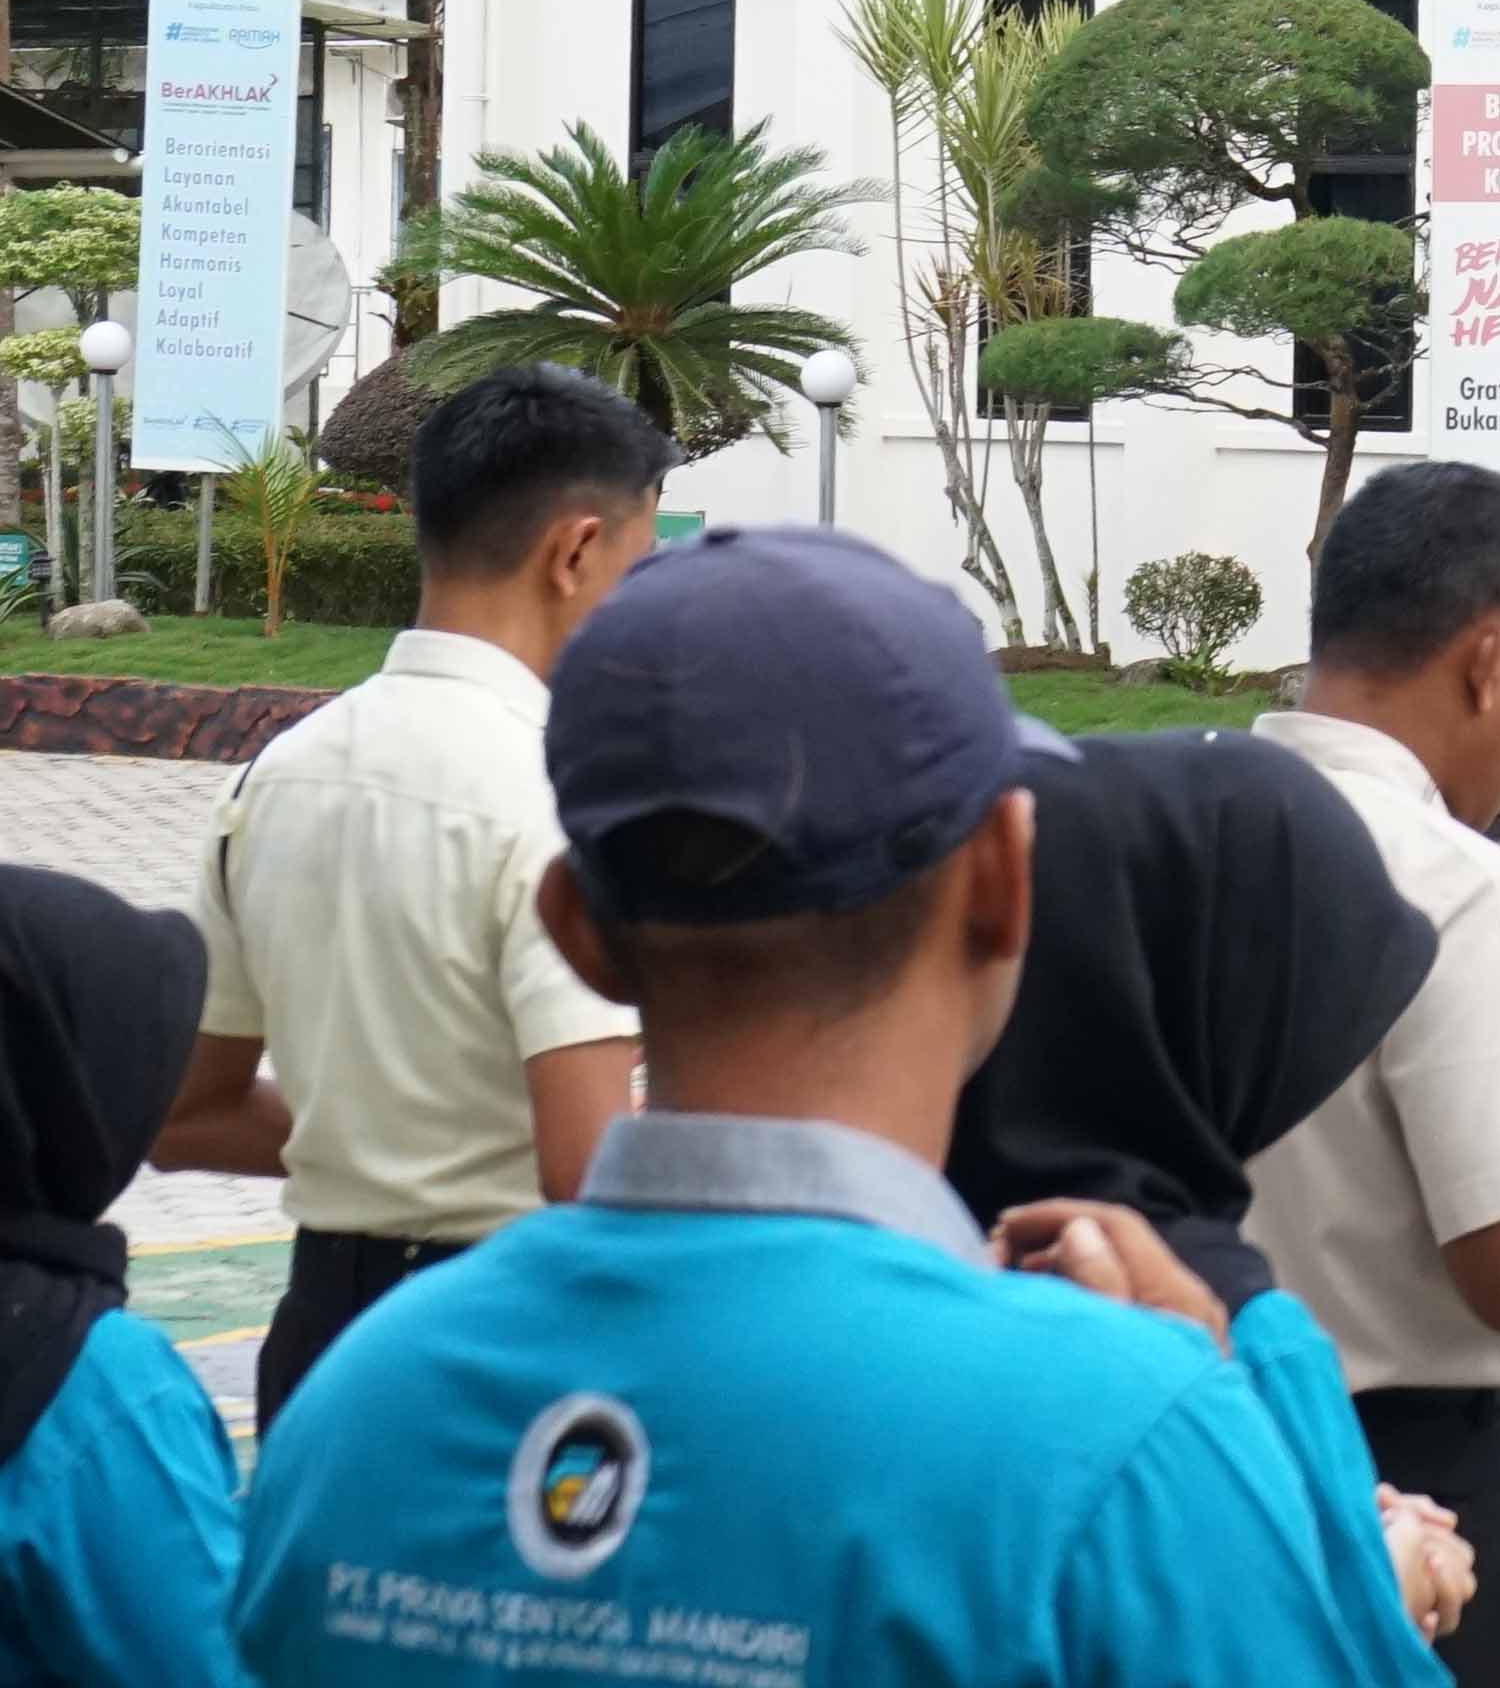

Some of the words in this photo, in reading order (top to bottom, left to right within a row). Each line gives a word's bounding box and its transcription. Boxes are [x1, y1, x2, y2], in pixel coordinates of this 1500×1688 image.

[161, 82, 272, 103] BerAKHLAK
[165, 137, 271, 160] Berorientasi
[163, 166, 235, 188] Layanan
[162, 194, 249, 216] Akuntabel
[161, 223, 247, 246] Kompeten
[160, 252, 241, 273] Harmonis
[158, 280, 203, 302] Loyal
[156, 309, 220, 332] Adaptif
[156, 336, 254, 359] Kolaboratif
